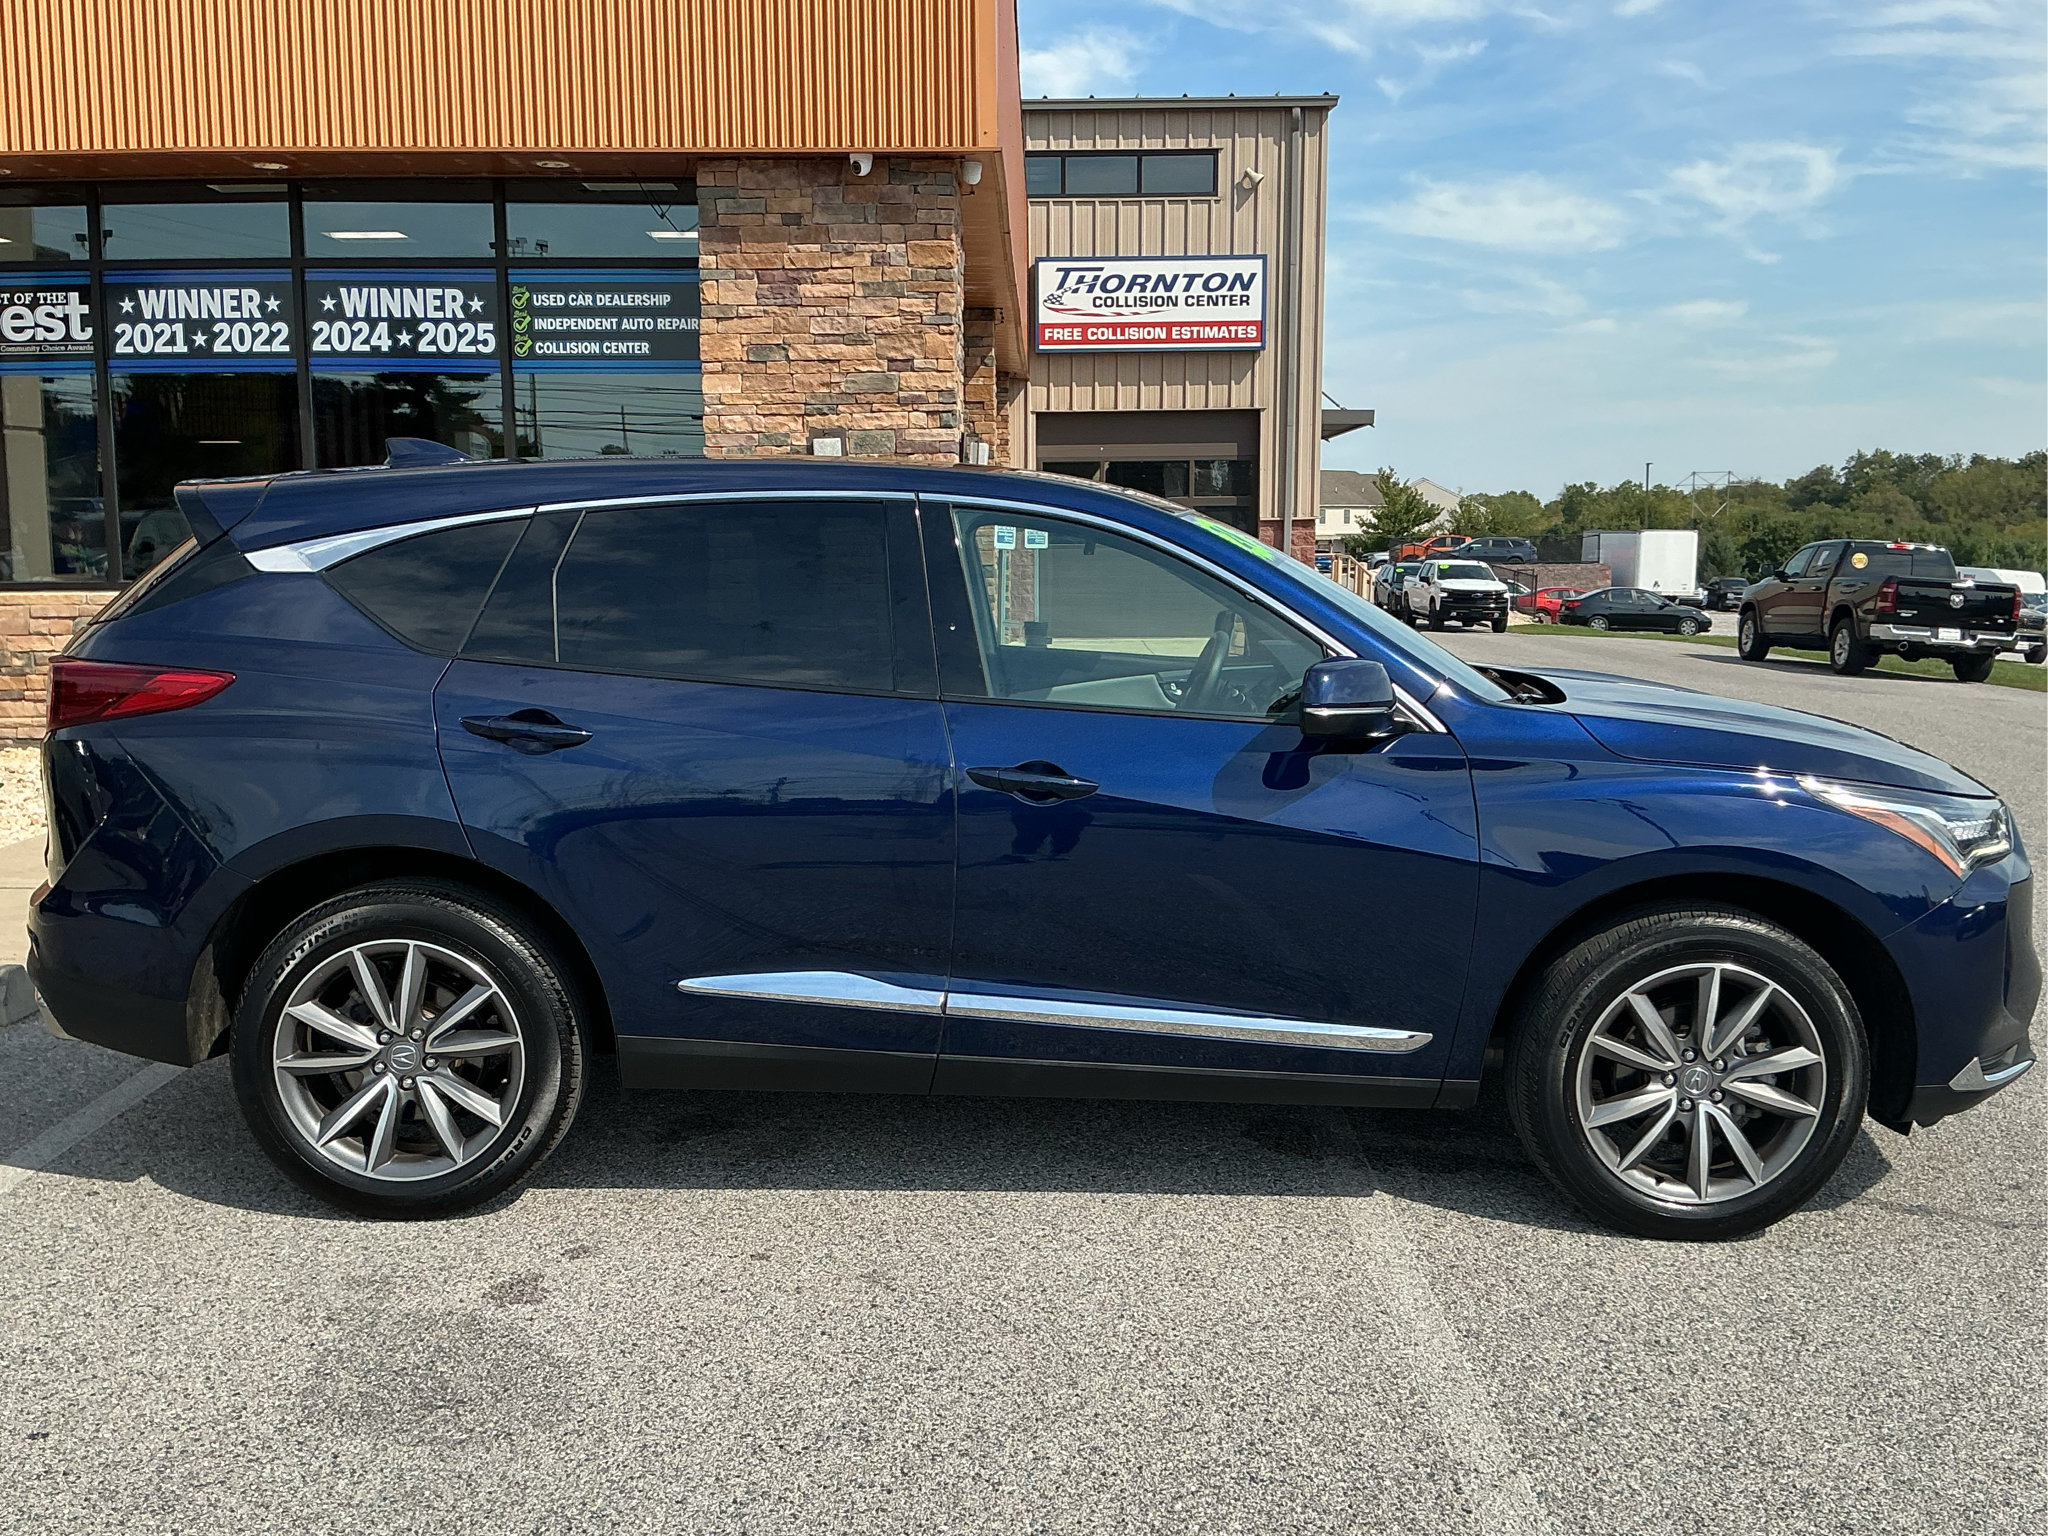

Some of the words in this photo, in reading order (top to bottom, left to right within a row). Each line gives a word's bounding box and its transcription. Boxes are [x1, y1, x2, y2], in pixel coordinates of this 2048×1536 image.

[1055, 267, 1257, 294] THORNTON
[14, 293, 33, 304] OF
[37, 292, 66, 304] THE
[137, 288, 262, 320] WINNER
[340, 287, 465, 319] WINNER
[533, 294, 565, 306] USED
[568, 294, 593, 306] CAR
[596, 294, 671, 306] DEALERSHIP
[1092, 294, 1178, 308] COLLISION
[1184, 294, 1250, 307] CENTER
[0, 292, 93, 341] est
[534, 318, 618, 330] INDEPENDENT
[621, 318, 654, 330] AUTO
[657, 318, 699, 330] REPAIR
[115, 323, 188, 353] 2021
[212, 322, 290, 352] 2022
[312, 321, 392, 352] 2024
[417, 321, 496, 353] 2025
[1044, 328, 1082, 341] FREE
[1087, 327, 1166, 340] COLLISION
[1171, 326, 1257, 340] ESTIMATES
[1, 345, 40, 353] Community
[535, 342, 600, 354] COLLISION
[603, 342, 649, 354] CENTER
